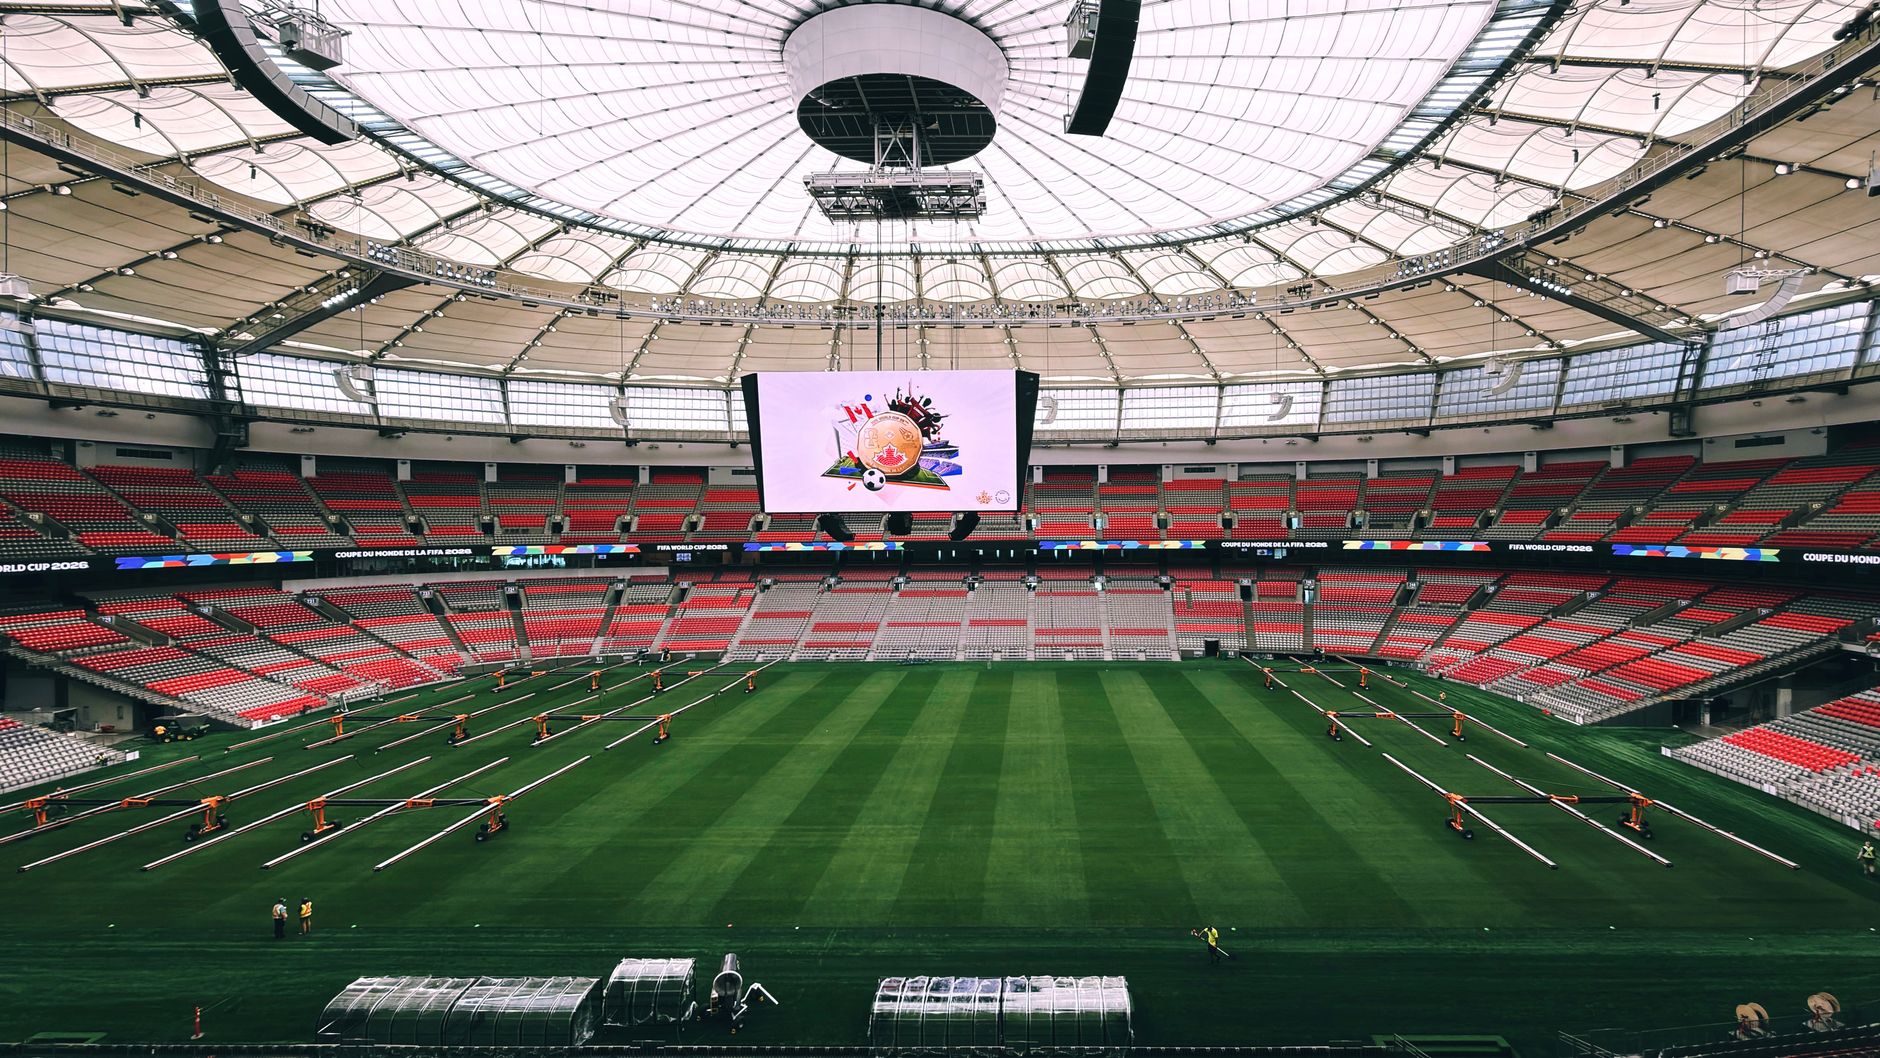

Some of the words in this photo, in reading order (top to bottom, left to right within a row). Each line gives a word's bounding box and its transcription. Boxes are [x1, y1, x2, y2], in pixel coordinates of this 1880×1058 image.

[1803, 553, 1834, 563] COUPE
[1834, 555, 1849, 563] DU
[1850, 555, 1880, 565] MOND
[27, 562, 50, 571] CUP
[51, 561, 88, 571] 2026
